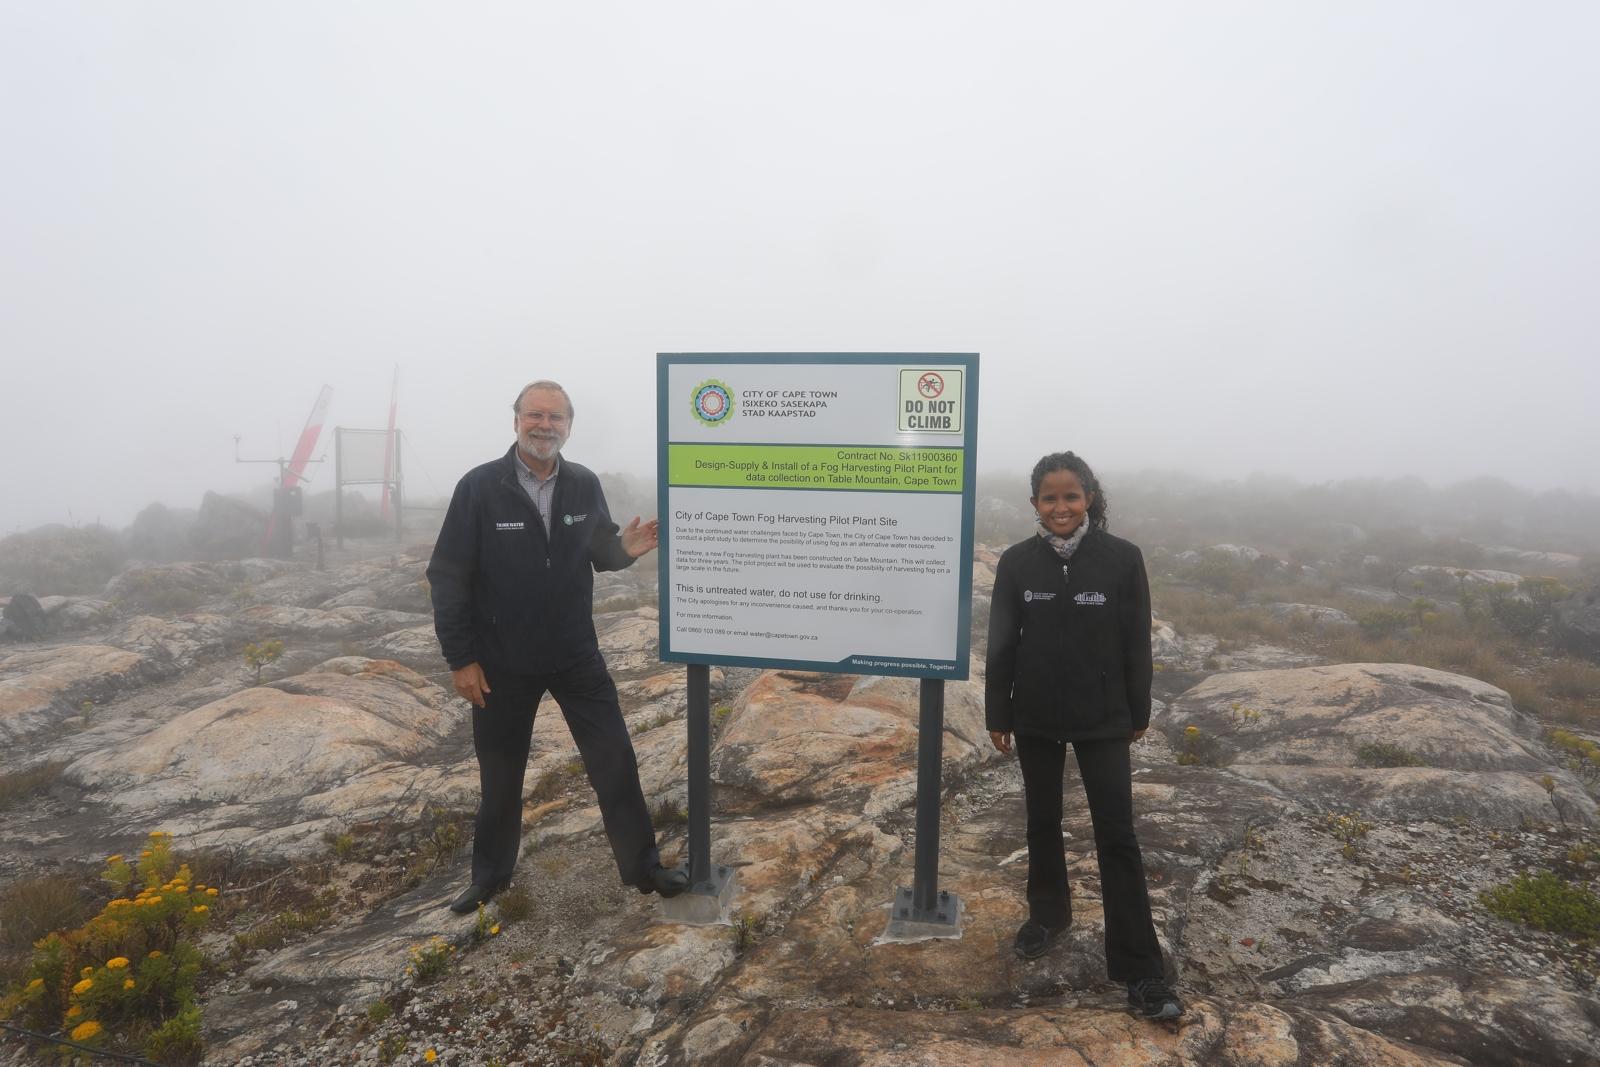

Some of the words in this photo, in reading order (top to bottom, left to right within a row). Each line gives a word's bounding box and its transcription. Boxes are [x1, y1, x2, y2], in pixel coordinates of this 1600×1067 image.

[768, 409, 816, 417] KAAPSTAD
[905, 400, 924, 413] DO
[929, 400, 955, 413] NOT
[908, 415, 951, 428] CLIMB
[837, 451, 877, 460] Contract
[879, 452, 896, 460] No.
[899, 452, 958, 461] Sk11900360
[695, 460, 760, 472] Design-Supply
[762, 461, 768, 470] &
[771, 462, 798, 470] Install
[800, 462, 810, 471] of
[820, 463, 838, 474] Fog
[841, 463, 892, 475] Harvesting
[894, 464, 915, 473] Pilot
[917, 465, 943, 474] Plant
[944, 465, 957, 474] for
[746, 472, 766, 481] data
[768, 472, 811, 482] collection
[828, 474, 854, 483] Table
[857, 474, 901, 485] Mountain,
[904, 476, 930, 487] Cape
[932, 476, 957, 486] Town
[675, 510, 692, 521] City
[694, 511, 703, 520] of
[705, 511, 729, 522] Cape
[732, 512, 755, 521] Town
[758, 513, 775, 524] Fog
[778, 514, 827, 526] Harvesting
[829, 515, 850, 524] Pilot
[852, 516, 877, 525] Plant
[879, 517, 898, 526] Site
[736, 551, 764, 560] harvesting
[894, 566, 925, 574] harvesting
[676, 583, 694, 592] This
[696, 584, 704, 593] is
[706, 585, 747, 595] untreated
[750, 587, 776, 597] water,
[779, 588, 791, 597] do
[793, 589, 808, 598] not
[829, 591, 842, 600] for
[844, 591, 883, 604] drinking.
[901, 661, 928, 670] possible.
[929, 663, 955, 671] Together
